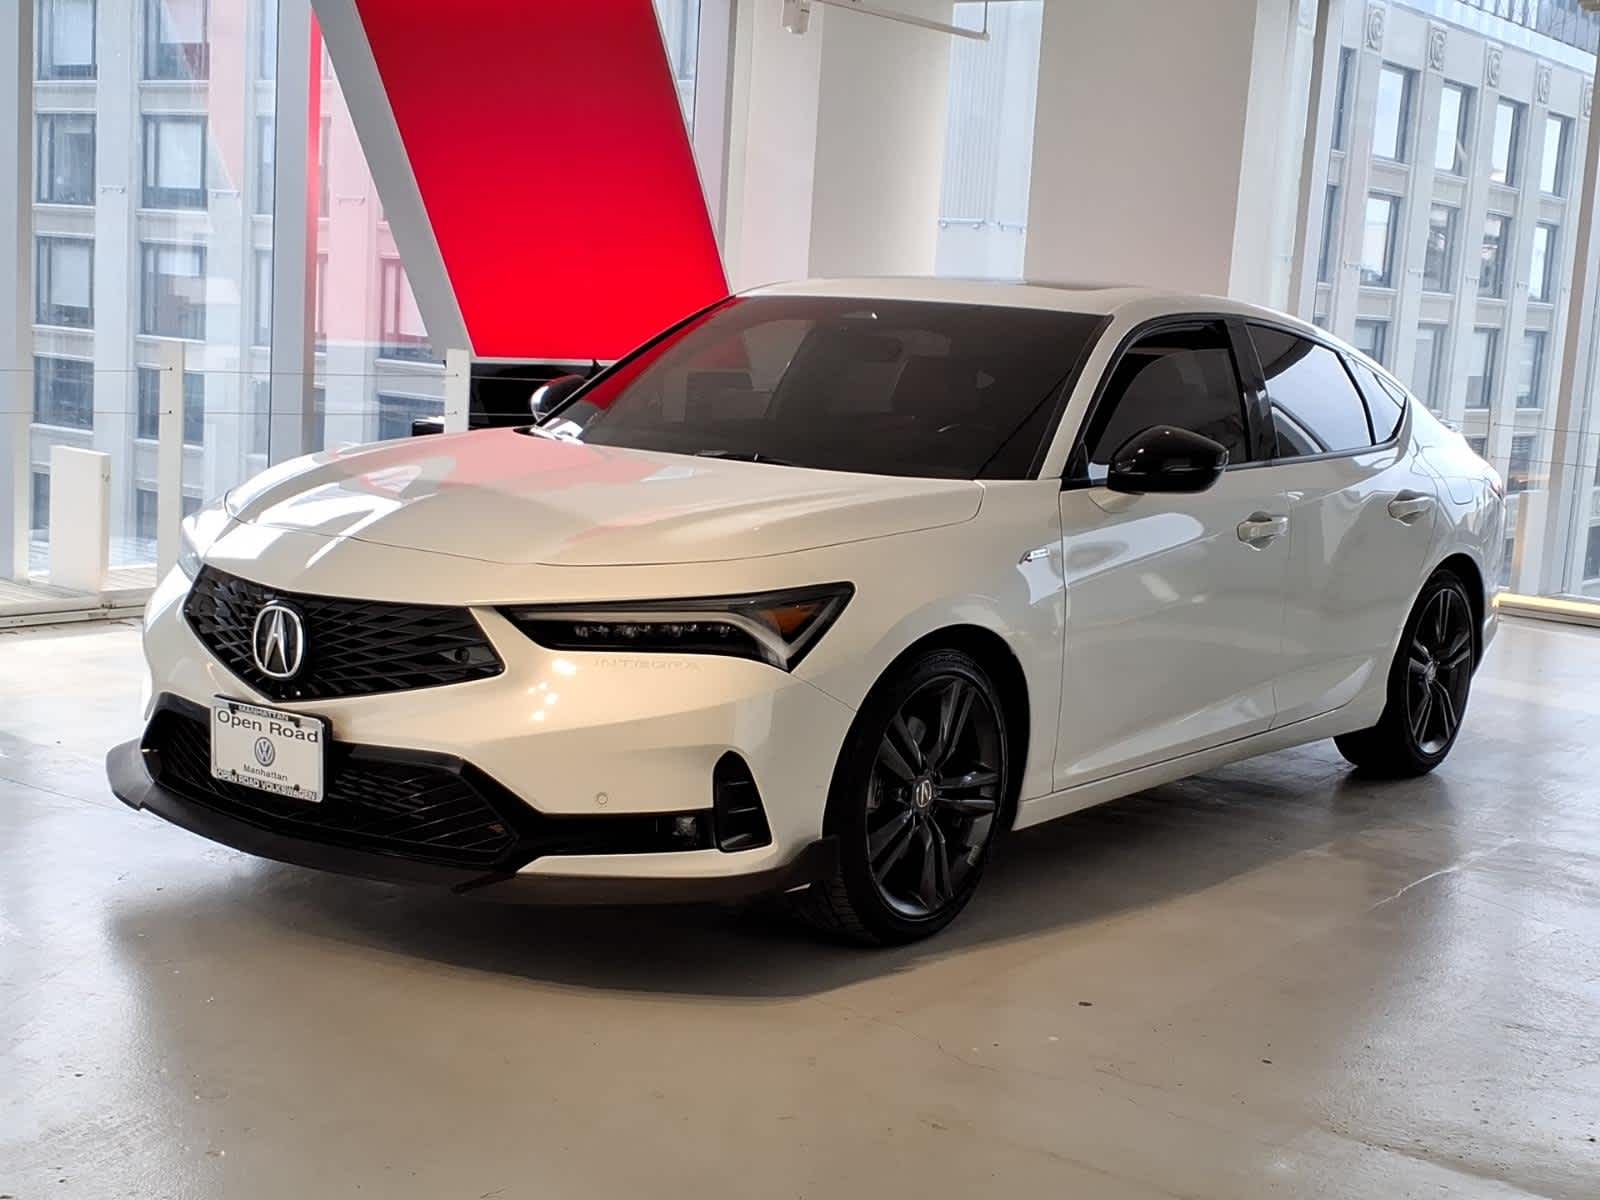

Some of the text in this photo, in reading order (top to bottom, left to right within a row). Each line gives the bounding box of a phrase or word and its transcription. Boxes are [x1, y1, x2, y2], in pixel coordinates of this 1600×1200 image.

[217, 710, 319, 743] Open Road
[243, 764, 288, 781] Manhattan
